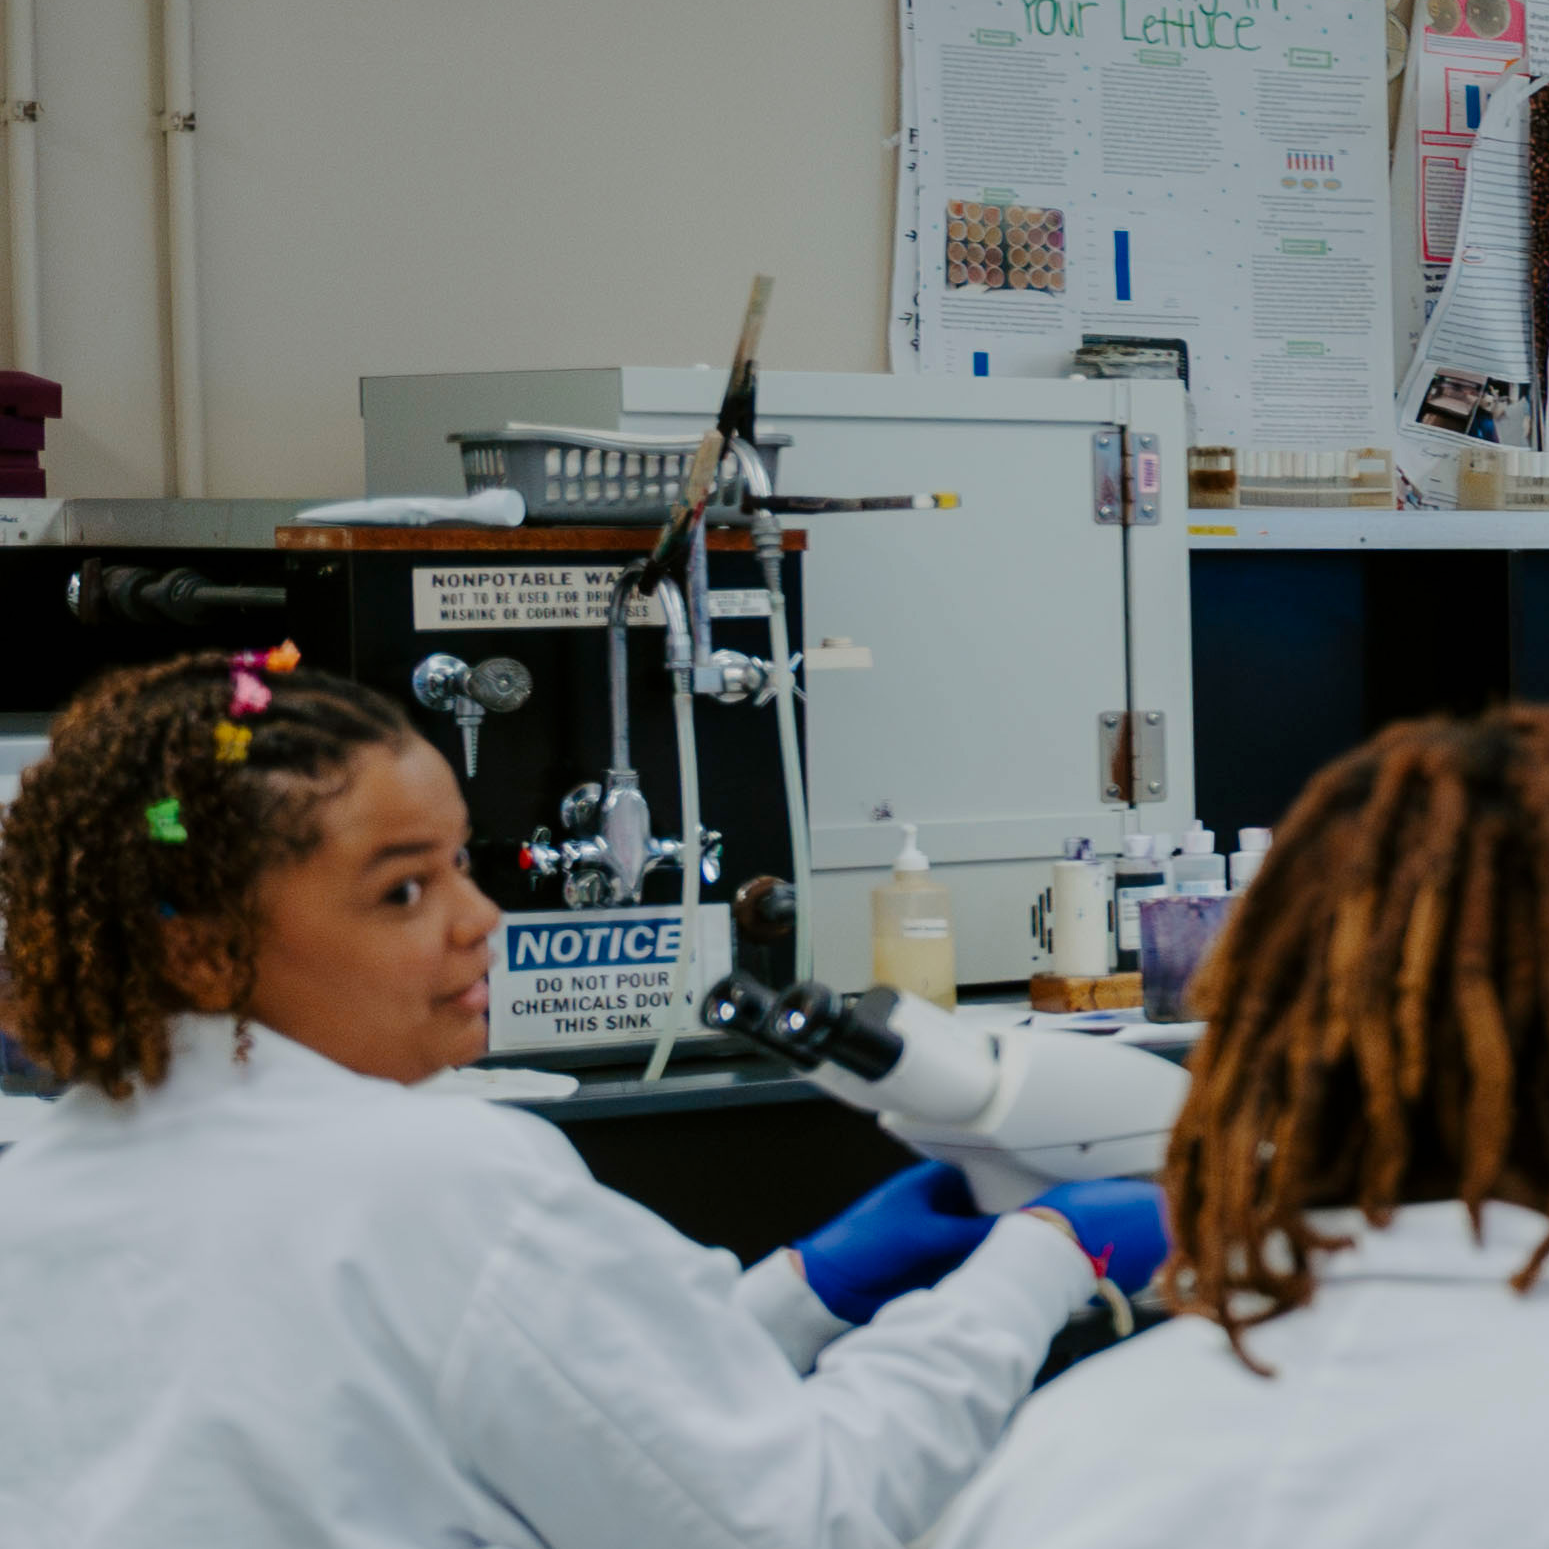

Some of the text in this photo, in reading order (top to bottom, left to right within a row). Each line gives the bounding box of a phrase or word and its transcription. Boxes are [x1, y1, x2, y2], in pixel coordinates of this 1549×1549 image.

[431, 571, 573, 588] NONPOTABLE
[518, 591, 548, 604] USED
[556, 591, 579, 604] FOR
[515, 924, 683, 966] NOTICE
[535, 971, 670, 994] DO NOT POUR
[511, 993, 628, 1016] CHEMICALS
[554, 1012, 652, 1033] THIS SINK
